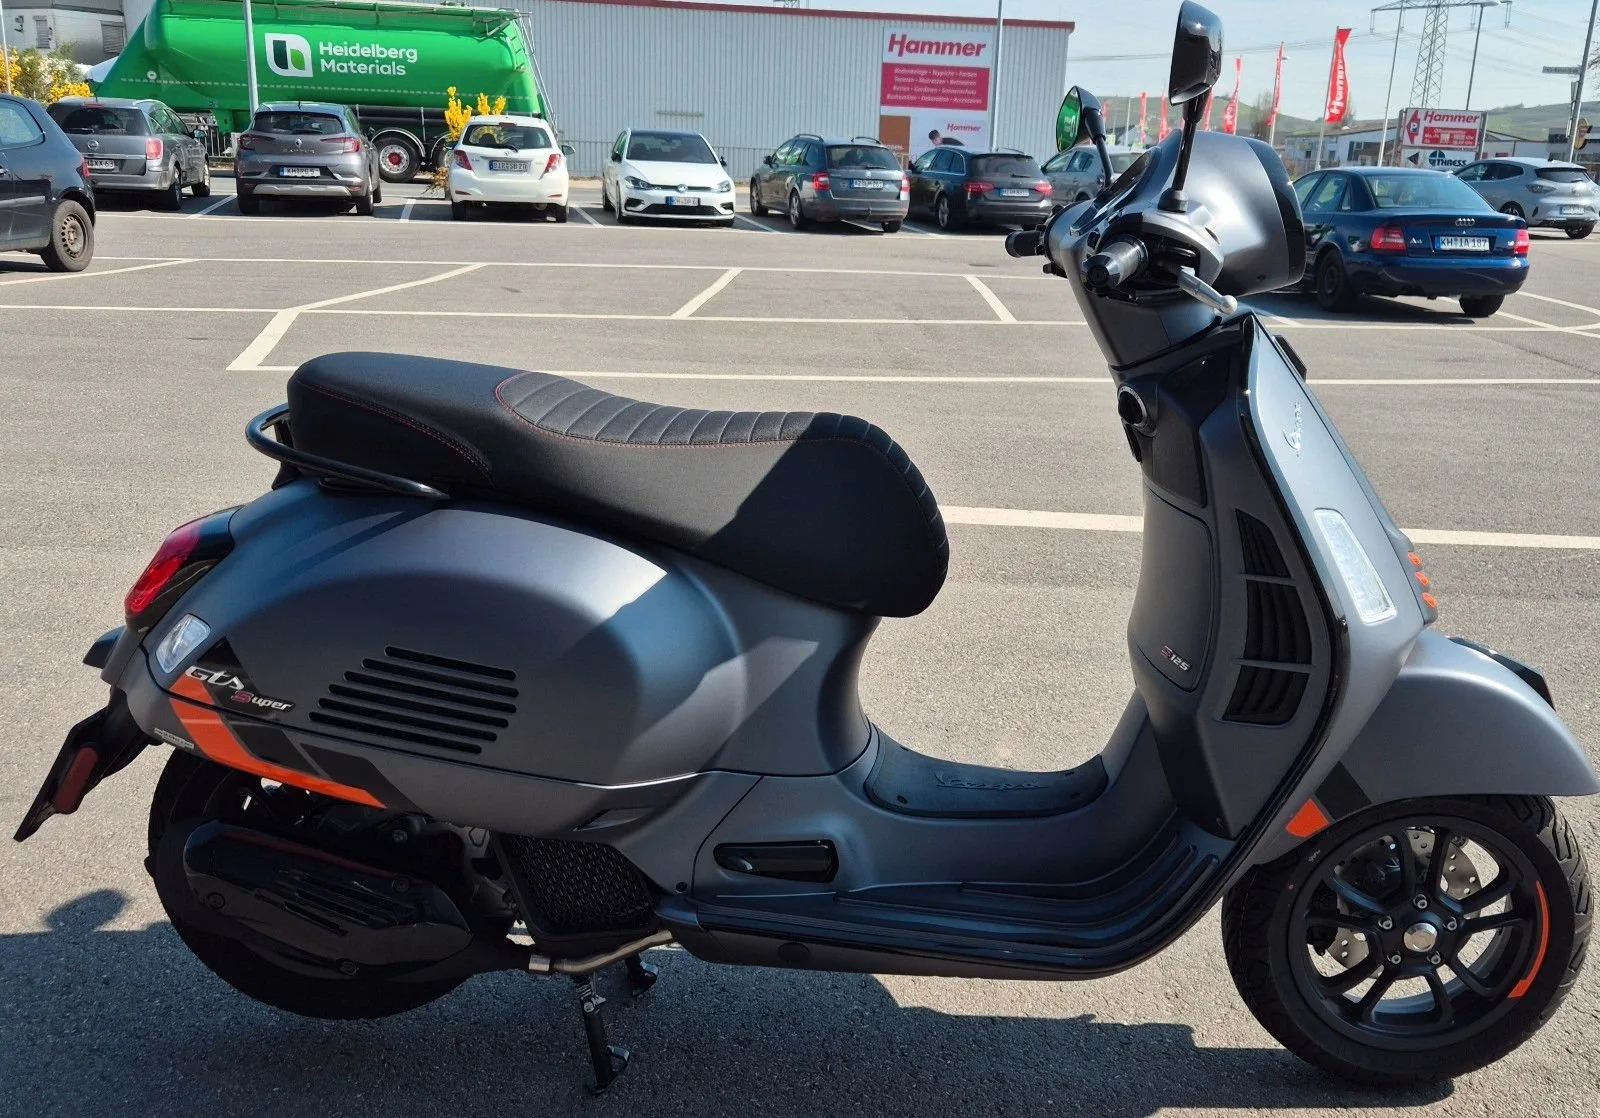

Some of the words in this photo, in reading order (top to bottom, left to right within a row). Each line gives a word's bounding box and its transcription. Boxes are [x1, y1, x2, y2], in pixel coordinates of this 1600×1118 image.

[319, 41, 418, 63] Heidelberg
[888, 33, 986, 57] Hammer
[320, 58, 407, 75] Materials
[1424, 111, 1480, 123] Hammer
[947, 123, 982, 132] Hammer
[1441, 237, 1453, 246] KH
[1472, 239, 1487, 247] 187
[231, 690, 292, 710] Super
